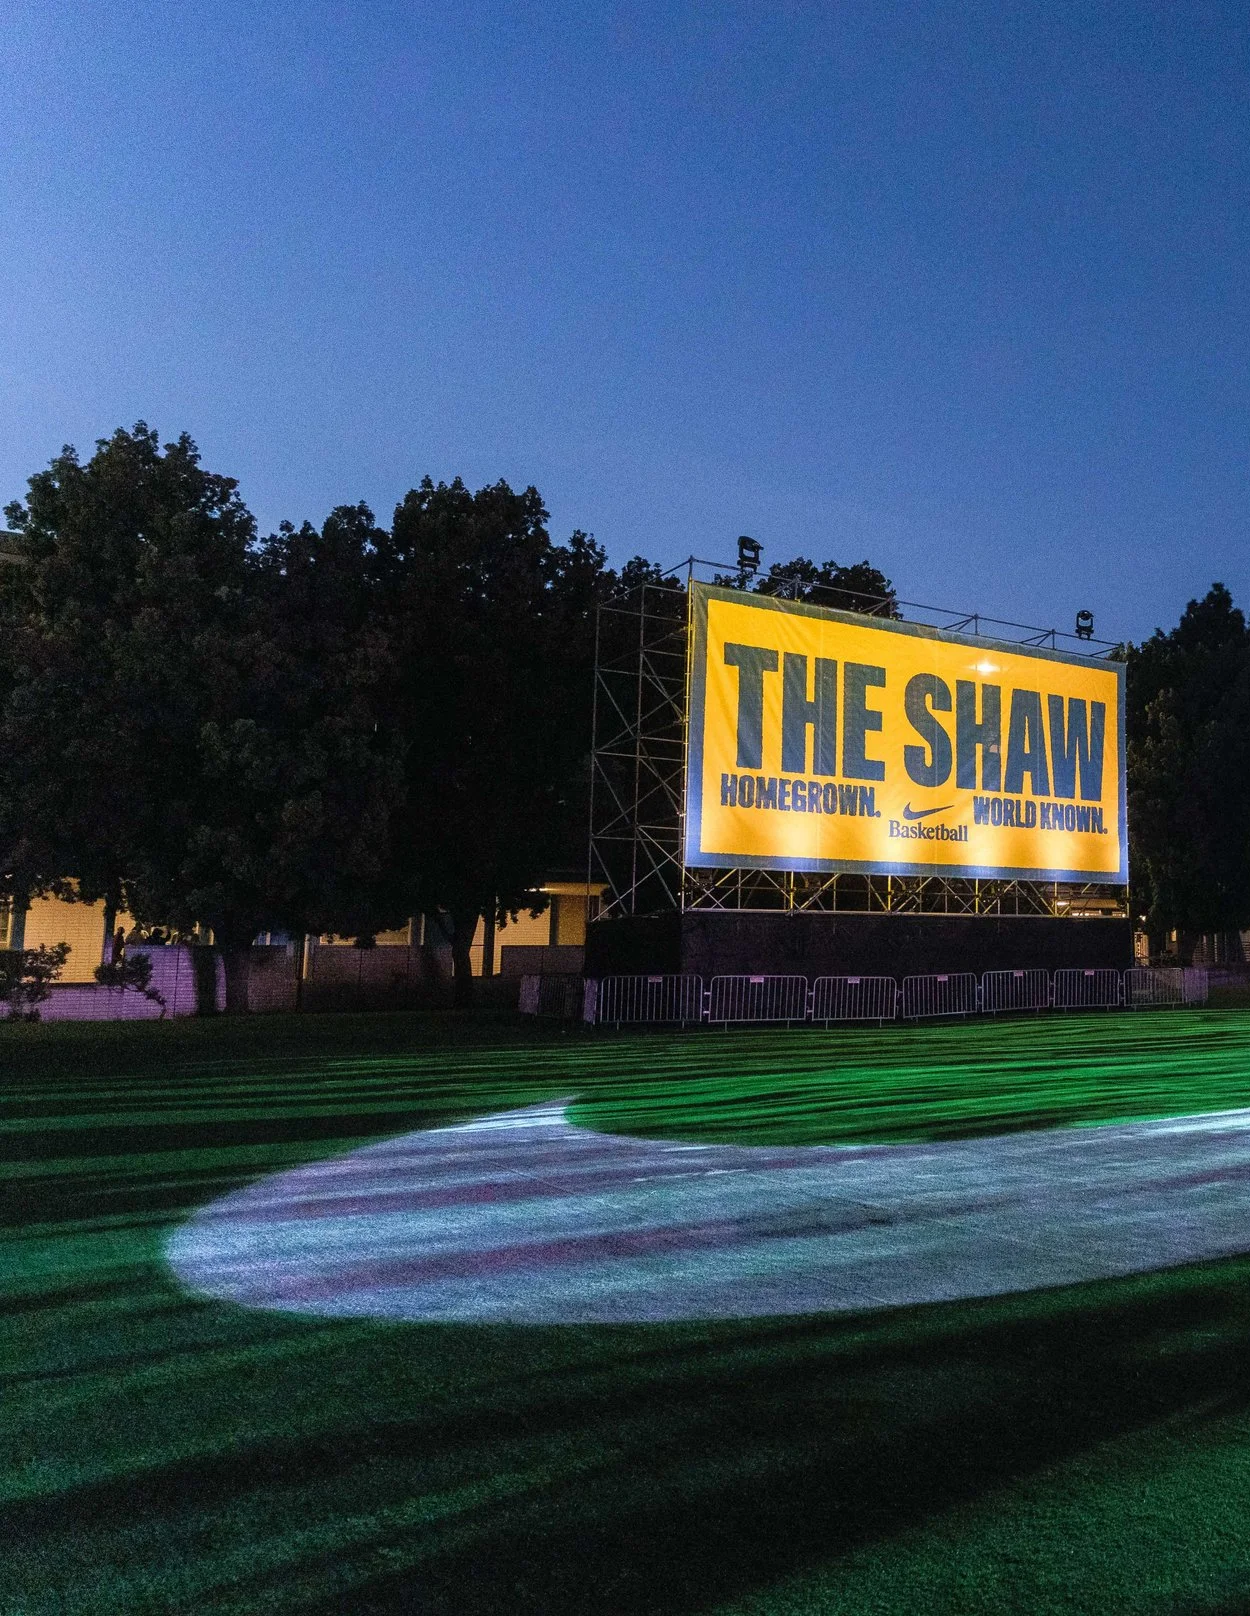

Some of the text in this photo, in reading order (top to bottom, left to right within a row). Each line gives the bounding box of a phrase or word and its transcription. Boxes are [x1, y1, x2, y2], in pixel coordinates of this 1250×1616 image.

[723, 642, 1106, 802] THE SHAW
[721, 773, 881, 818] HOMEGROWN.
[973, 796, 1108, 834] WORLD KNOWN.
[888, 819, 969, 842] Basketball
